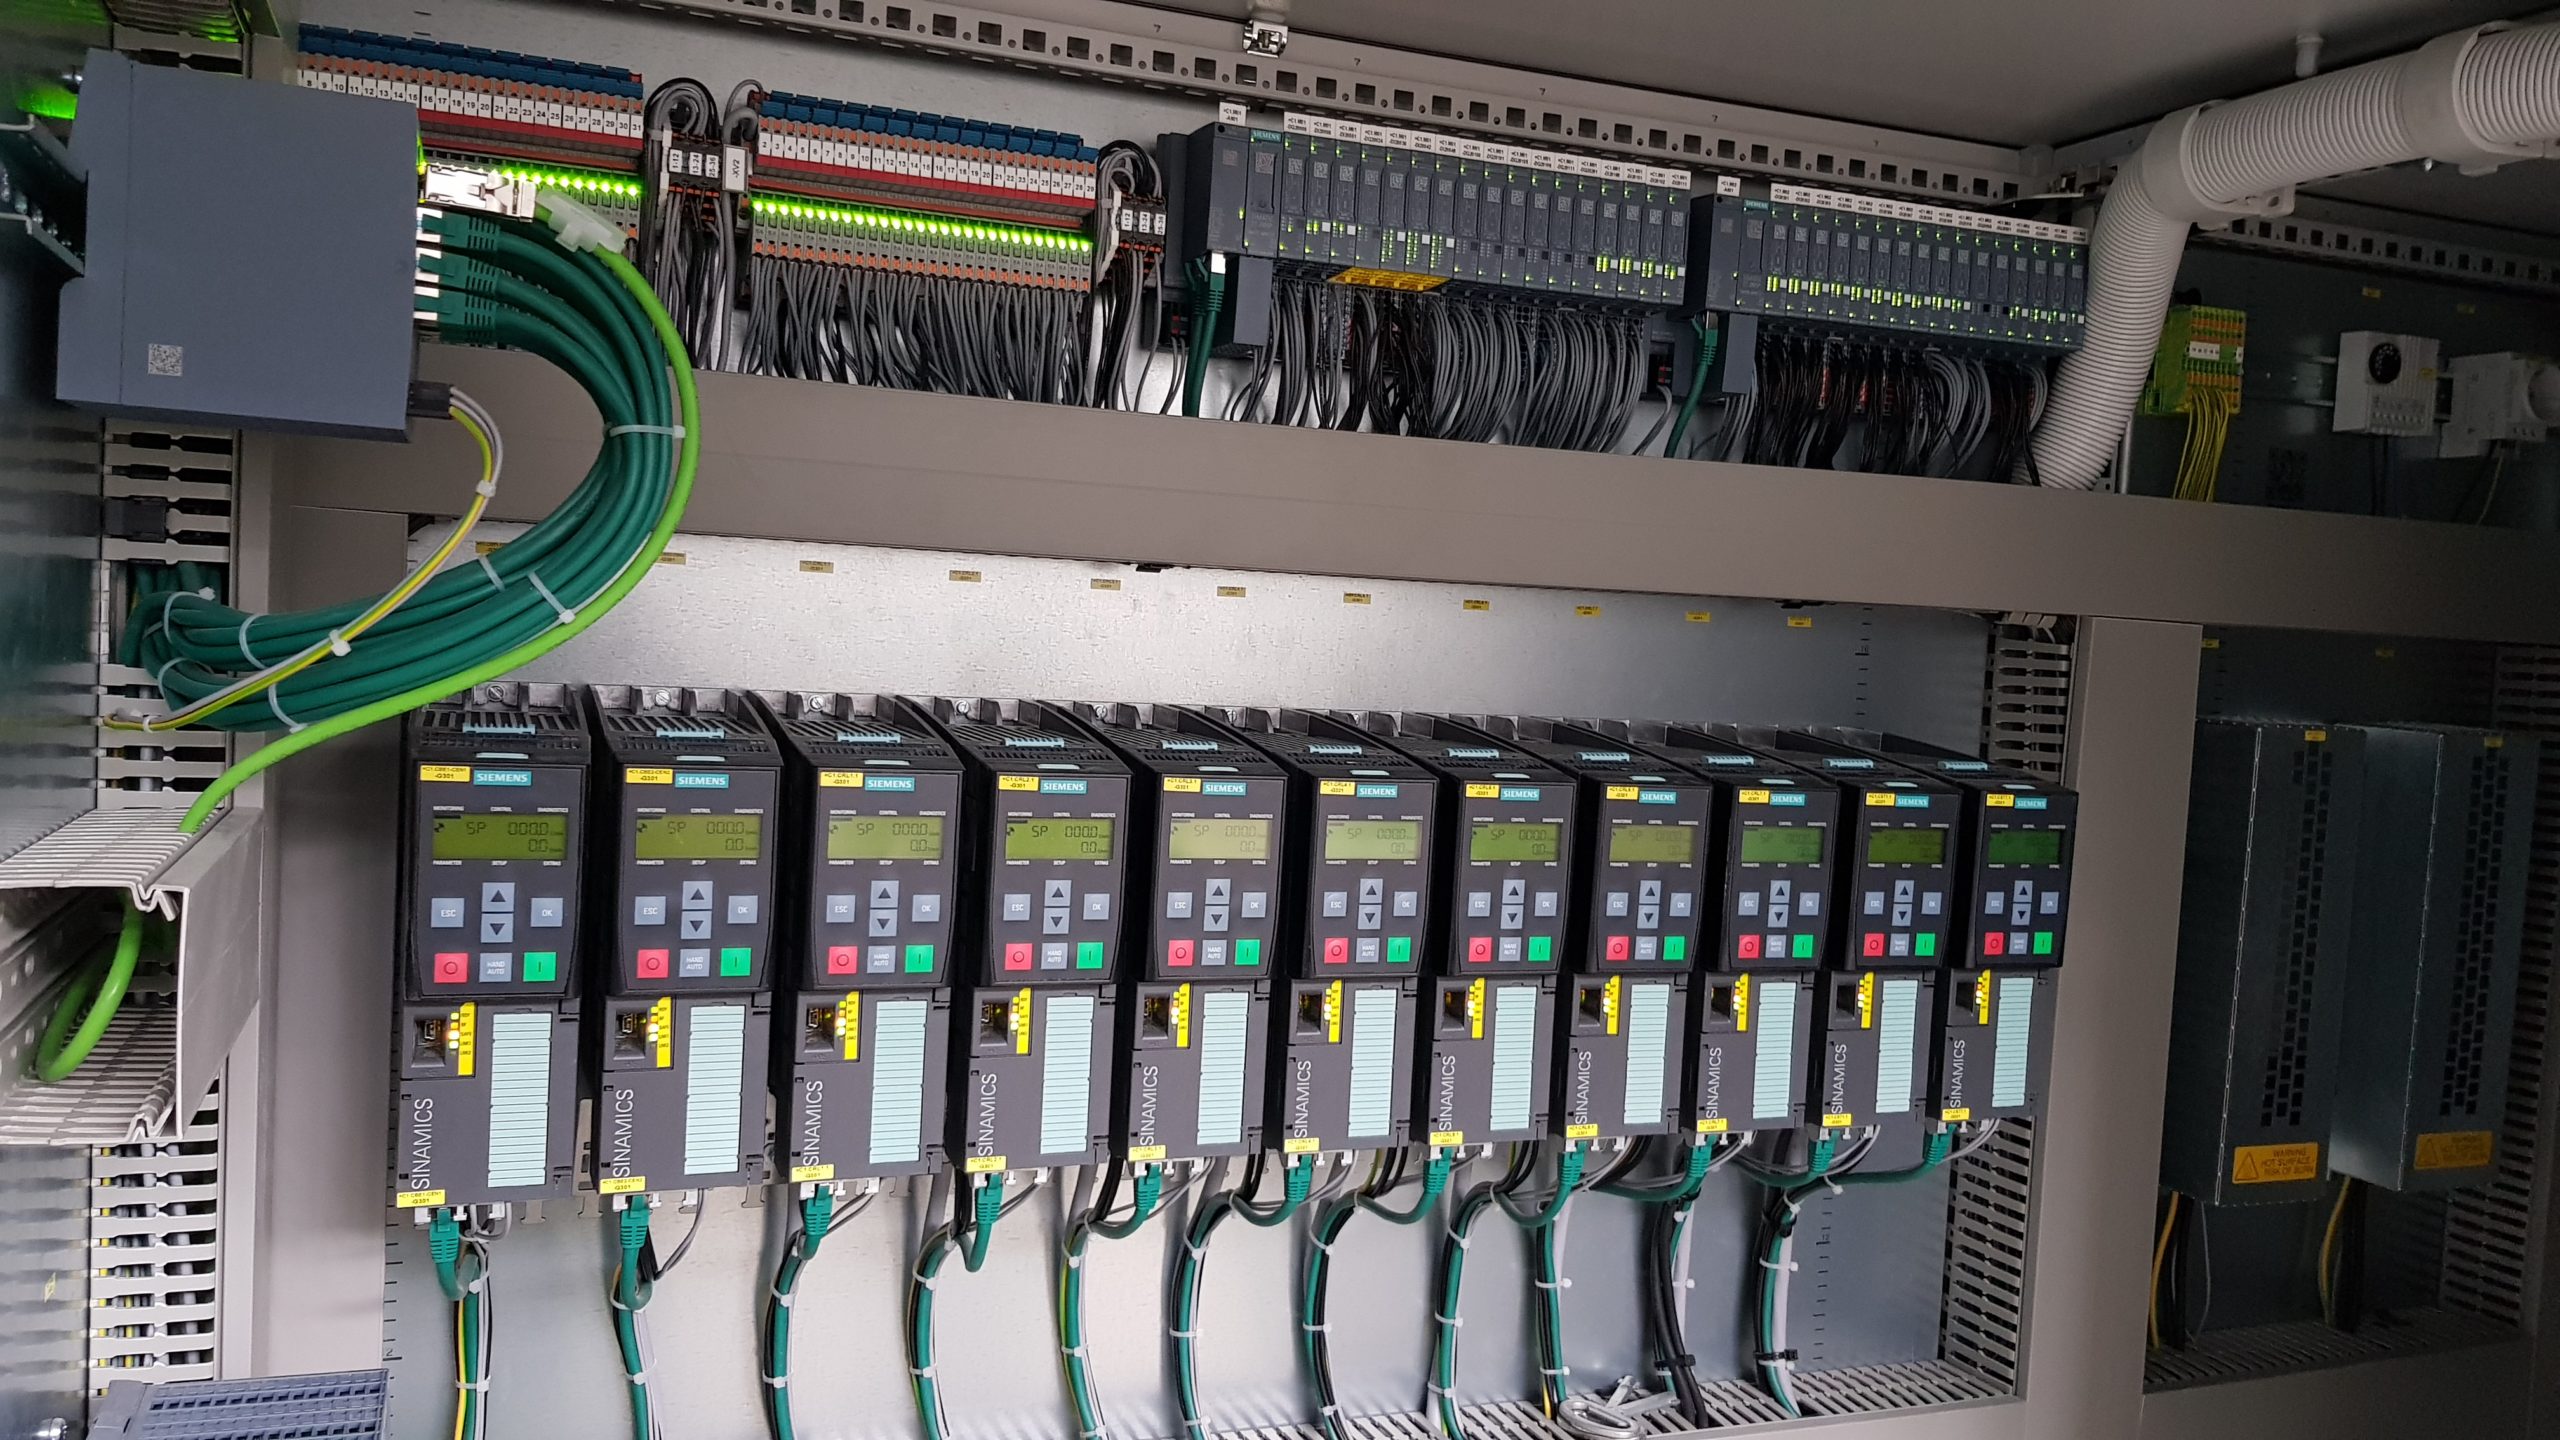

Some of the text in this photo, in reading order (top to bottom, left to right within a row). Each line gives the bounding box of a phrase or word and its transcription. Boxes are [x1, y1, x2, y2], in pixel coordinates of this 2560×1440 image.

[334, 83, 344, 92] 10
[349, 86, 359, 94] 11
[364, 88, 374, 96] 12
[378, 90, 389, 98] 13
[394, 91, 403, 99] 14
[408, 93, 418, 101] 15
[424, 95, 433, 103] 16
[452, 99, 461, 107] 18
[466, 101, 476, 109] 19
[480, 103, 491, 112] 20
[509, 107, 518, 115] 22
[537, 110, 547, 119] 24
[550, 112, 561, 121] 25
[564, 114, 574, 122] 26
[592, 118, 601, 126] 28
[619, 122, 629, 131] 30
[632, 123, 643, 132] 31
[672, 153, 680, 169] 1-12
[861, 154, 871, 163] 10
[886, 158, 894, 166] 12
[692, 154, 700, 174] 13-24
[732, 159, 740, 178] -XV2
[898, 159, 907, 169] 13
[911, 161, 920, 170] 14
[922, 164, 931, 172] 15
[936, 164, 944, 174] 16
[959, 168, 968, 177] 18
[971, 169, 980, 178] 19
[981, 170, 991, 180] 20
[994, 172, 1004, 181] 21
[1006, 174, 1016, 183] 22
[1018, 175, 1027, 184] 23
[1030, 177, 1039, 186] 24
[1041, 179, 1050, 187] 25
[1051, 180, 1061, 189] 26
[1063, 182, 1073, 191] 27
[1075, 183, 1084, 192] 28
[1087, 184, 1096, 193] 29
[477, 773, 528, 782] SIEMENS
[677, 777, 726, 785] SIEMENS
[867, 780, 912, 788] SIEMENS
[1043, 783, 1085, 791] SIEMENS
[1205, 785, 1244, 793] SIEMENS
[1503, 790, 1537, 798] SIEMENS
[1641, 793, 1674, 801] SIEMENS
[1771, 796, 1803, 804] SIEMENS
[2017, 800, 2046, 808] SIEMENS
[466, 821, 487, 836] SP
[667, 821, 687, 835] SP
[856, 823, 874, 836] SP
[1031, 825, 1049, 838] SP
[834, 905, 848, 913] ESC
[921, 905, 932, 913] OK
[1011, 904, 1024, 912] ESC
[1092, 903, 1101, 911] OK
[1330, 901, 1342, 909] ESC
[440, 909, 456, 918] ESC
[542, 909, 553, 917] OK
[643, 907, 658, 915] ESC
[737, 906, 748, 914] OK
[1950, 1039, 1966, 1108] SINAMICS
[1705, 1047, 1722, 1119] SINAMICS
[1831, 1044, 1847, 1114] SINAMICS
[1575, 1050, 1592, 1125] SINAMICS
[1438, 1055, 1456, 1132] SINAMICS
[1293, 1060, 1312, 1139] SINAMICS
[1139, 1065, 1159, 1146] SINAMICS
[978, 1073, 997, 1157] SINAMICS
[803, 1080, 824, 1166] SINAMICS
[613, 1088, 634, 1178] SINAMICS
[411, 1098, 434, 1190] SINAMICS
